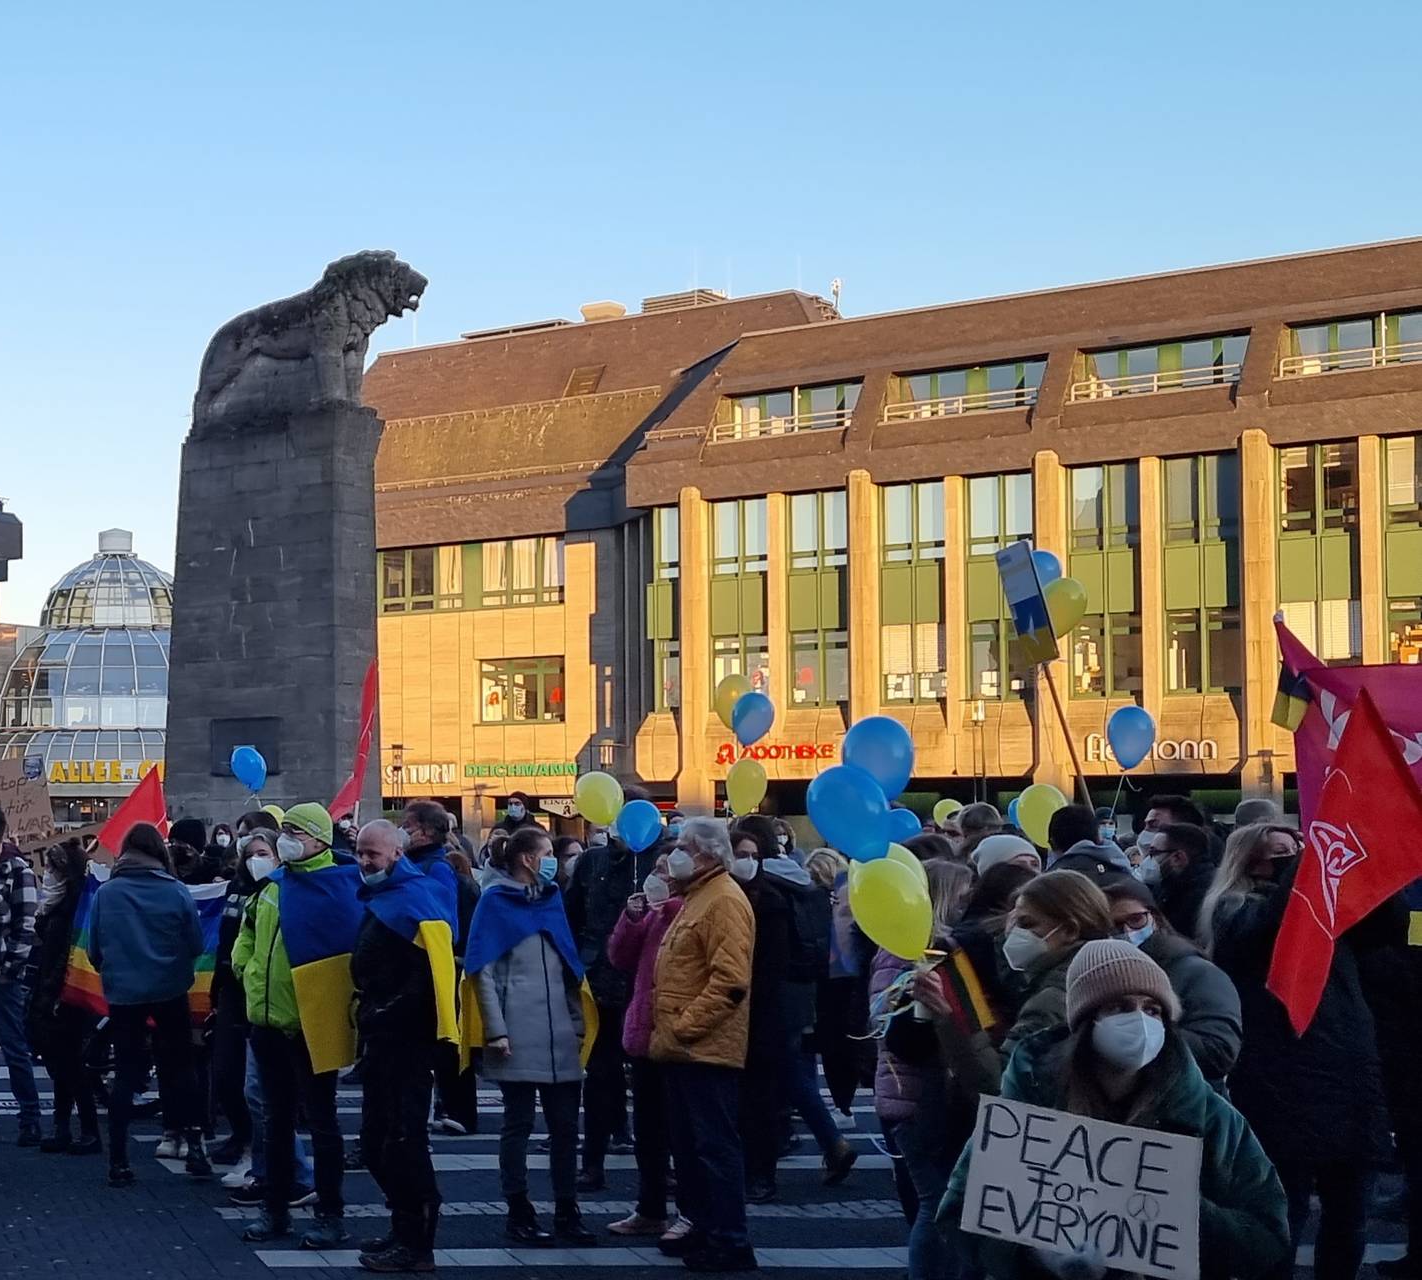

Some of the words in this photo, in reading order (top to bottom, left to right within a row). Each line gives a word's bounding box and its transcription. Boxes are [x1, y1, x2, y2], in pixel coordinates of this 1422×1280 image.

[384, 763, 457, 785] SATURN
[465, 763, 579, 778] DEICHMANN
[18, 815, 53, 833] WAR
[980, 1103, 1173, 1195] PEACE
[977, 1184, 1180, 1271] EVERYONE
